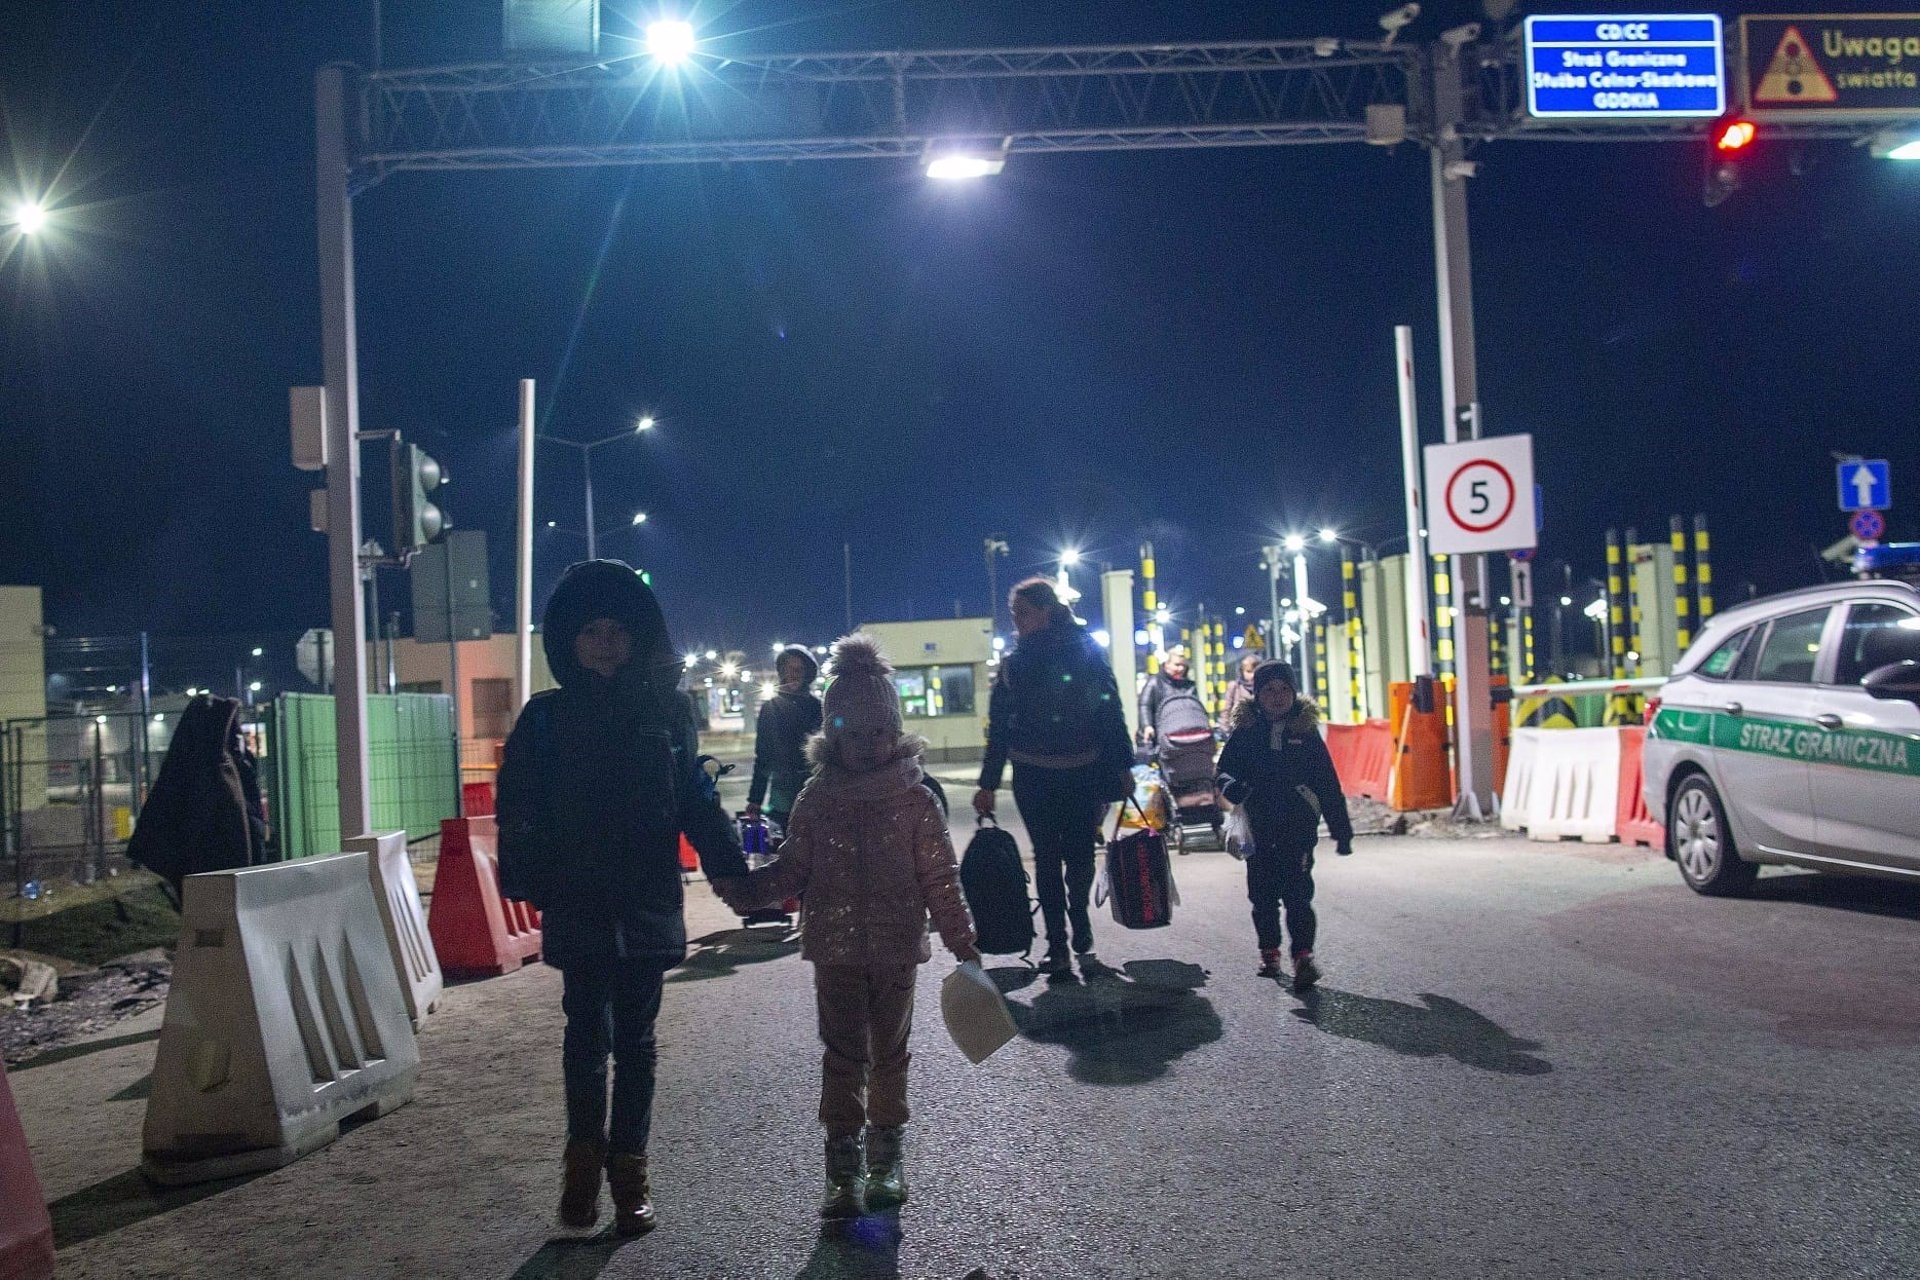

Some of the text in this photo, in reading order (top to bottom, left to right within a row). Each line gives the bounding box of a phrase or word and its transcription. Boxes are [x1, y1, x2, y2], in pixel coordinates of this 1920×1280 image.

[1823, 29, 1920, 65] Uwaga
[1470, 481, 1489, 514] 5
[1740, 722, 1908, 768] STRAŻ GRANICZNA
